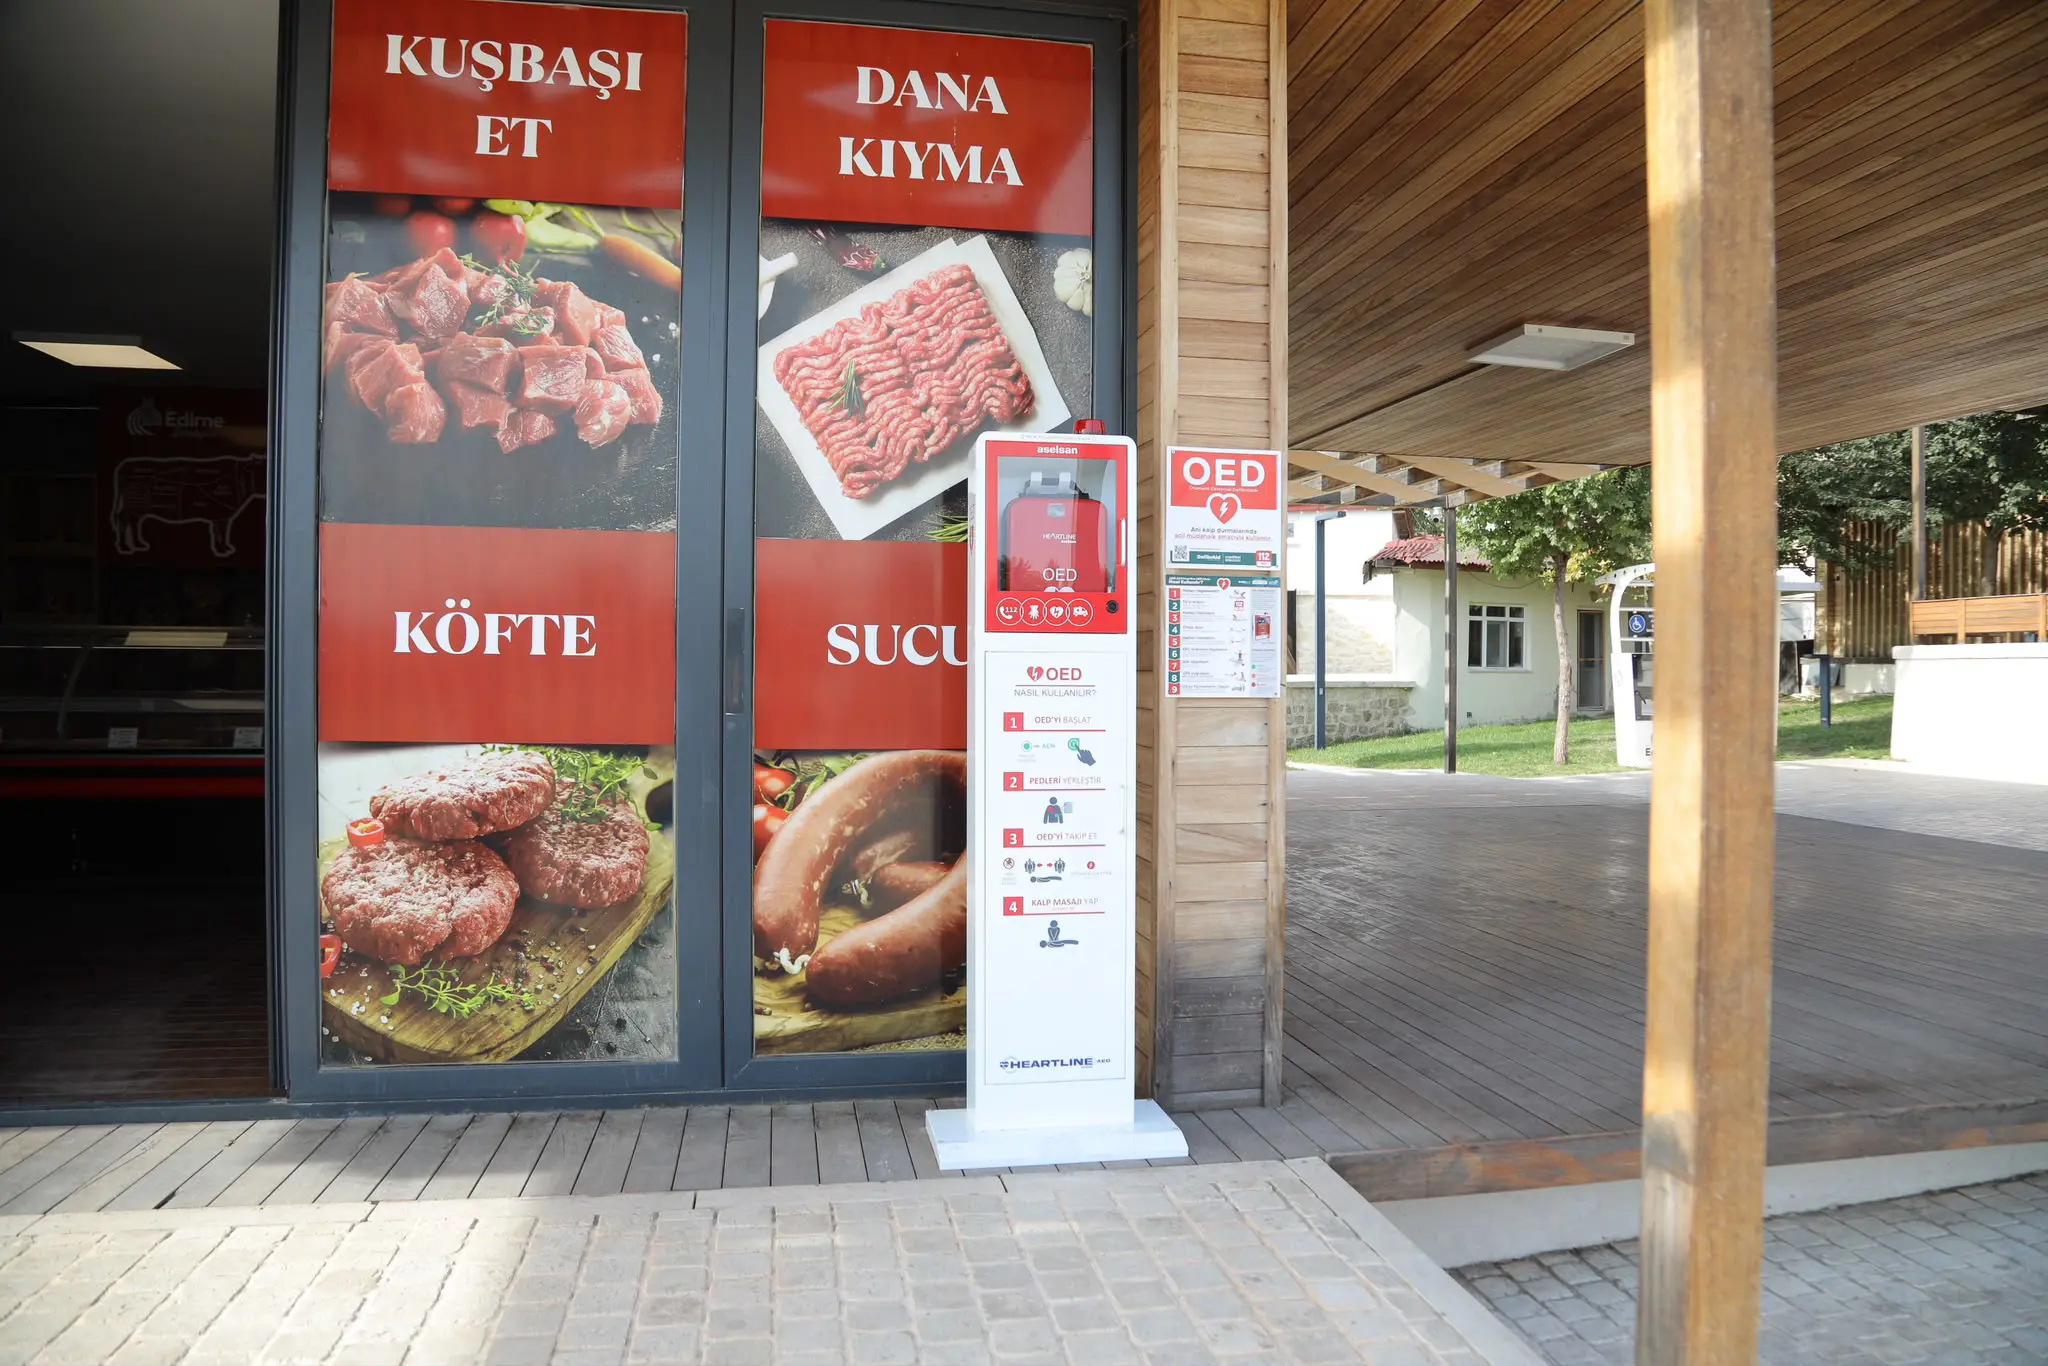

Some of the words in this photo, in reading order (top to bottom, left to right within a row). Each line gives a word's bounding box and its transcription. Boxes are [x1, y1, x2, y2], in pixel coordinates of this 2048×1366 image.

[385, 34, 643, 100] KUŞBAŞI
[855, 66, 1009, 115] DANA
[474, 115, 552, 158] ET
[838, 137, 1024, 187] KIYMA
[1037, 445, 1079, 455] aselsan
[1182, 456, 1266, 487] OED
[1258, 552, 1270, 561] 112
[1042, 568, 1078, 582] OED
[1172, 602, 1178, 610] 2
[1172, 614, 1178, 622] 3
[393, 598, 597, 657] KÖFTE
[1172, 626, 1178, 634] 4
[1172, 638, 1178, 646] 5
[1172, 650, 1178, 658] 6
[1172, 662, 1178, 670] 7
[1046, 667, 1082, 681] OED
[1172, 674, 1178, 682] 8
[1014, 688, 1040, 697] NASIL
[1041, 688, 1097, 697] KULLANILIR?
[1009, 717, 1018, 729] 1
[1062, 716, 1092, 725] BAŞLAT
[1009, 776, 1018, 788] 2
[1029, 775, 1061, 785] PEDLERİ
[1009, 833, 1018, 845] 3
[1088, 832, 1097, 840] ET
[1008, 901, 1018, 912] 4
[1031, 899, 1051, 907] KALP
[1083, 897, 1099, 905] YAP
[1010, 1058, 1093, 1069] HEARTLINE
